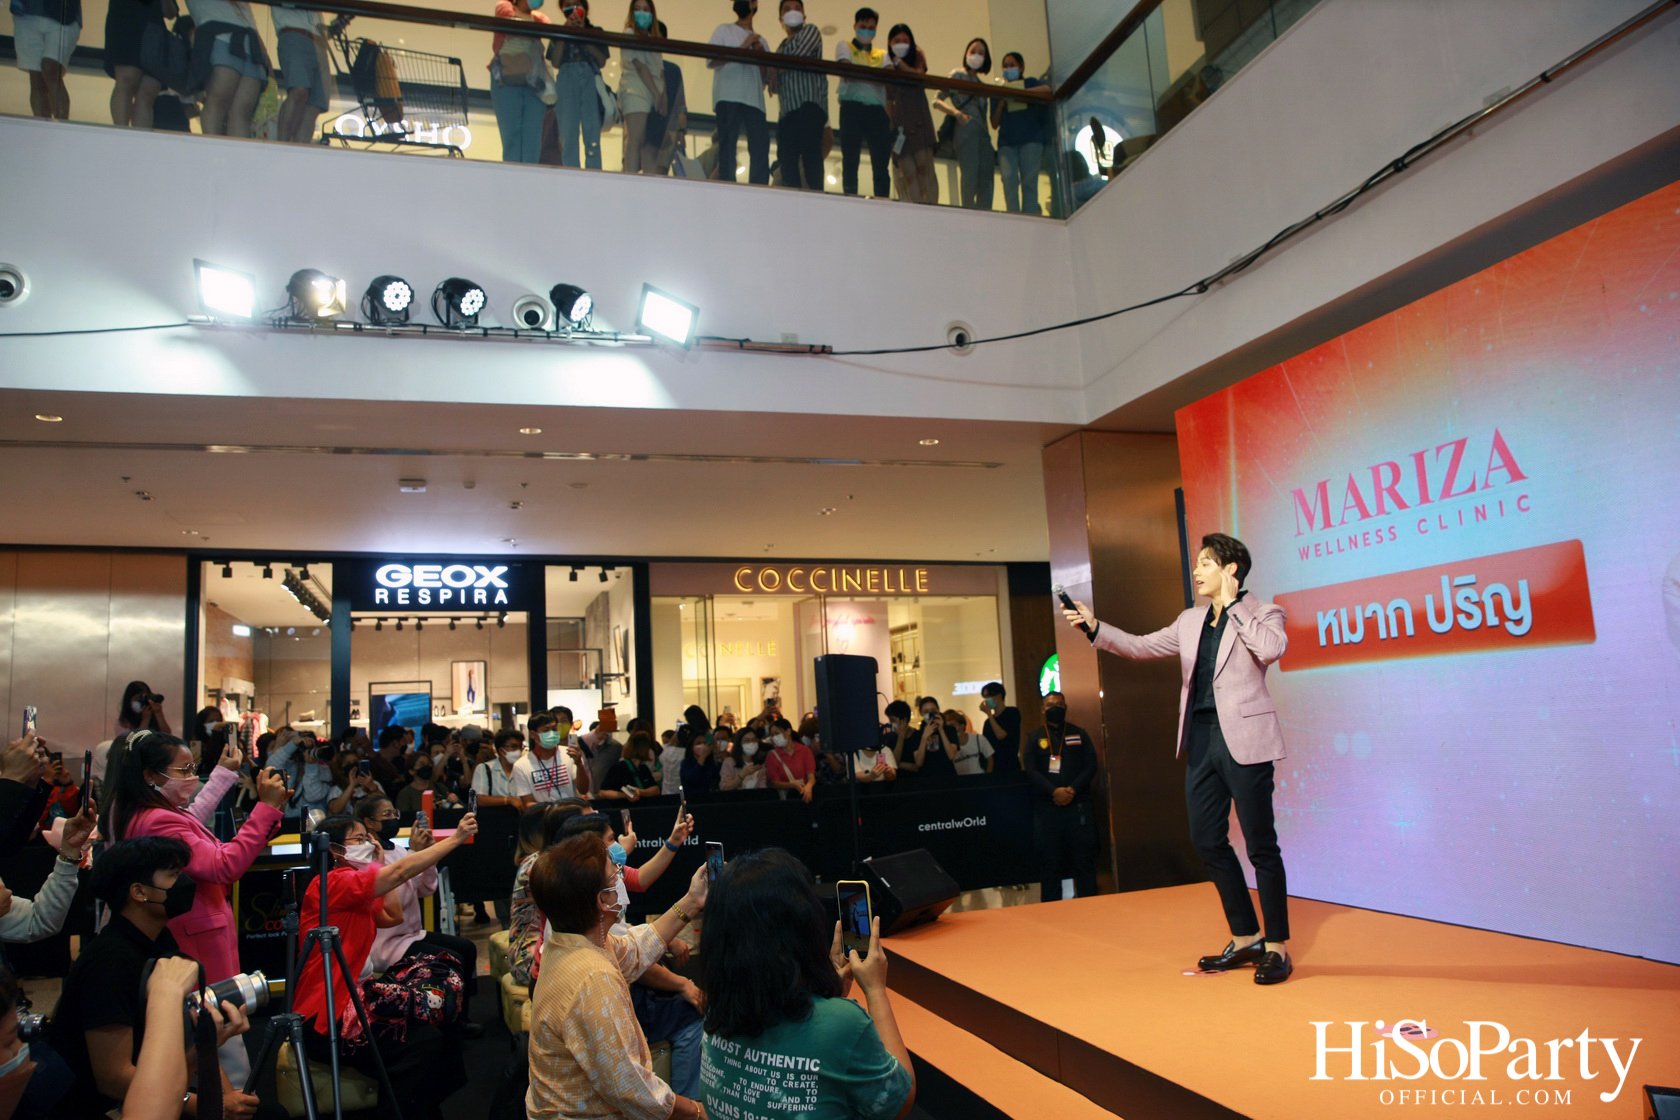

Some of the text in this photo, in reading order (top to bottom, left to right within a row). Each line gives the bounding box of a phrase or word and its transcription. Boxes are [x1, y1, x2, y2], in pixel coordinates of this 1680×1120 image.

[1290, 427, 1529, 538] MARIZA
[1298, 494, 1531, 561] WELLNESS CLINIC
[375, 564, 509, 588] GEOX
[734, 566, 929, 593] COCCINELLE
[375, 588, 509, 605] RESPIRA
[1317, 574, 1533, 647] หมาก ปริญ
[918, 816, 987, 832] centralwOrld
[711, 1035, 742, 1056] MOST
[744, 1048, 821, 1072] AUTHENTIC
[724, 1056, 742, 1068] THING
[745, 1064, 768, 1077] ABOUT
[770, 1071, 781, 1079] US
[739, 1077, 747, 1086] TO
[767, 1078, 777, 1086] TO
[723, 1087, 740, 1099] THAN
[743, 1096, 756, 1105] OUR
[733, 1083, 817, 1104] TO LOVE AND TO
